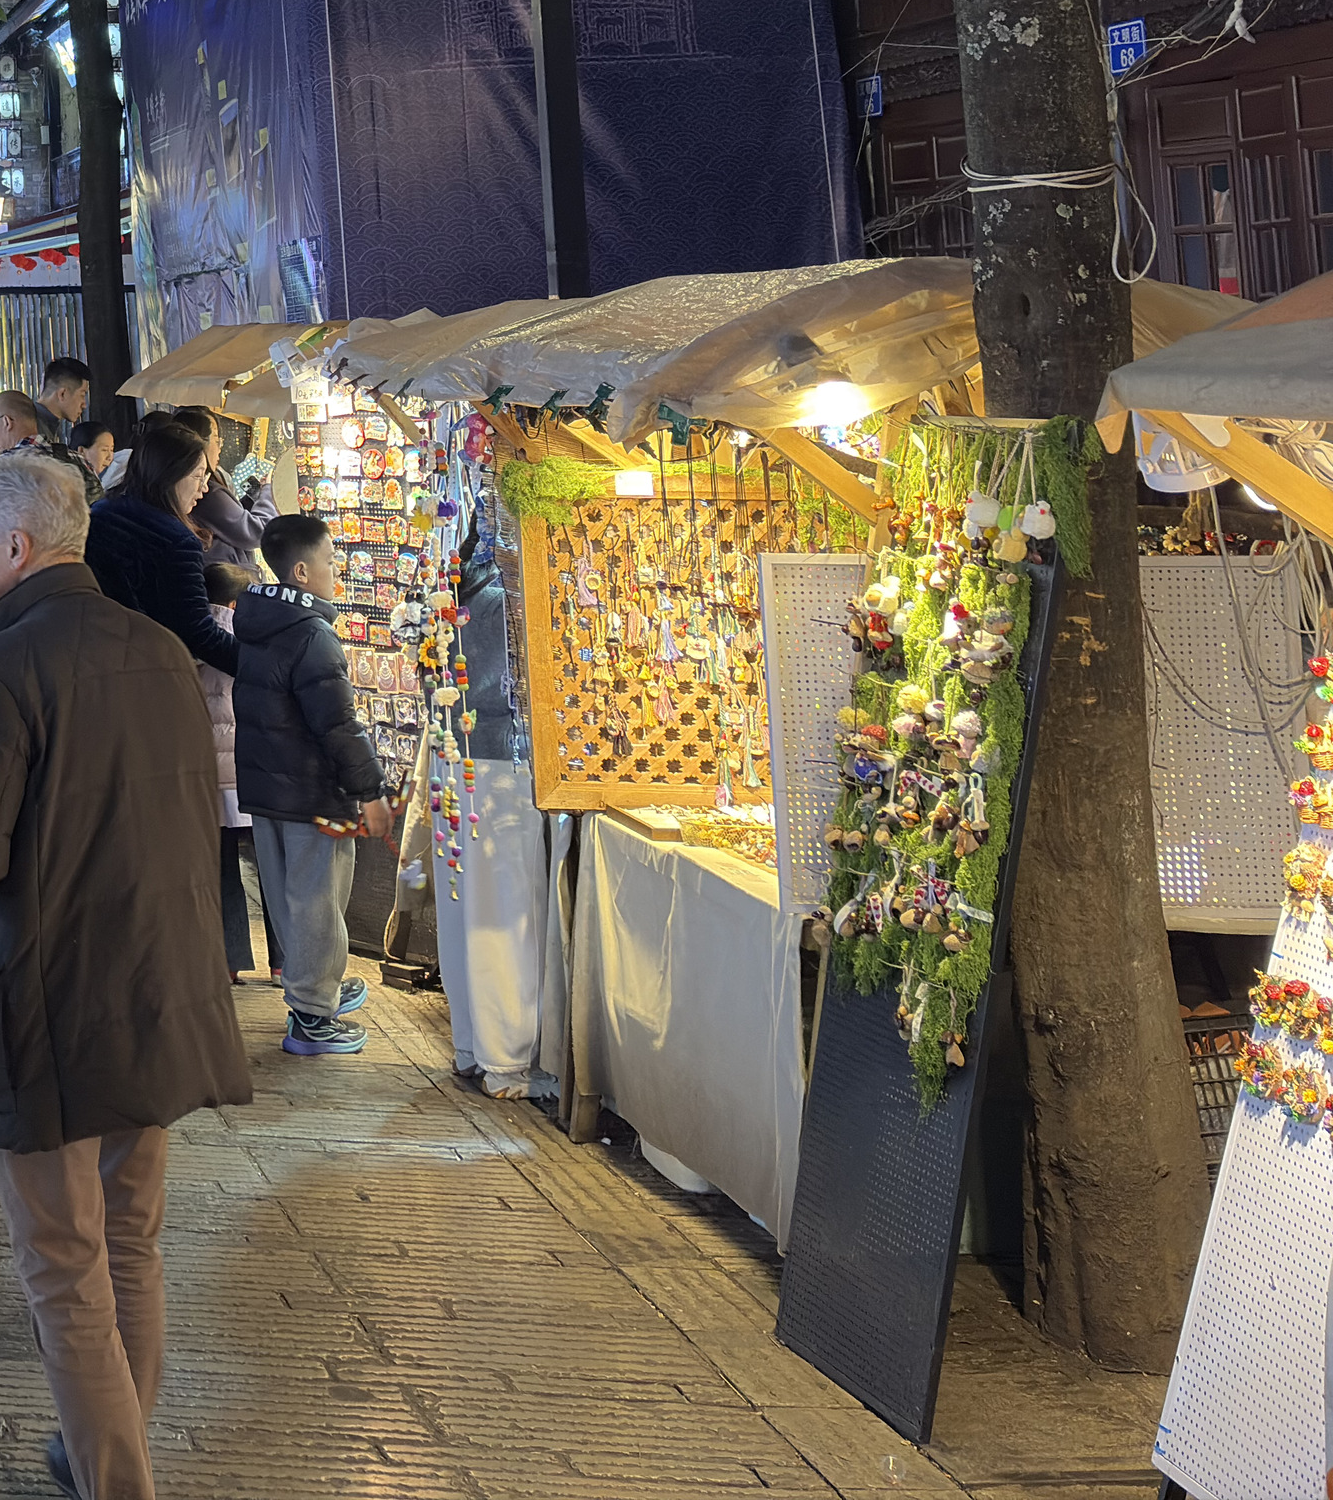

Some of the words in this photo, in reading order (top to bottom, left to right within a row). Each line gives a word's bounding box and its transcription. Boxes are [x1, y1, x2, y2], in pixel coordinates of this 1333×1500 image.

[1113, 25, 1140, 45] 文明街
[1120, 48, 1135, 67] 68
